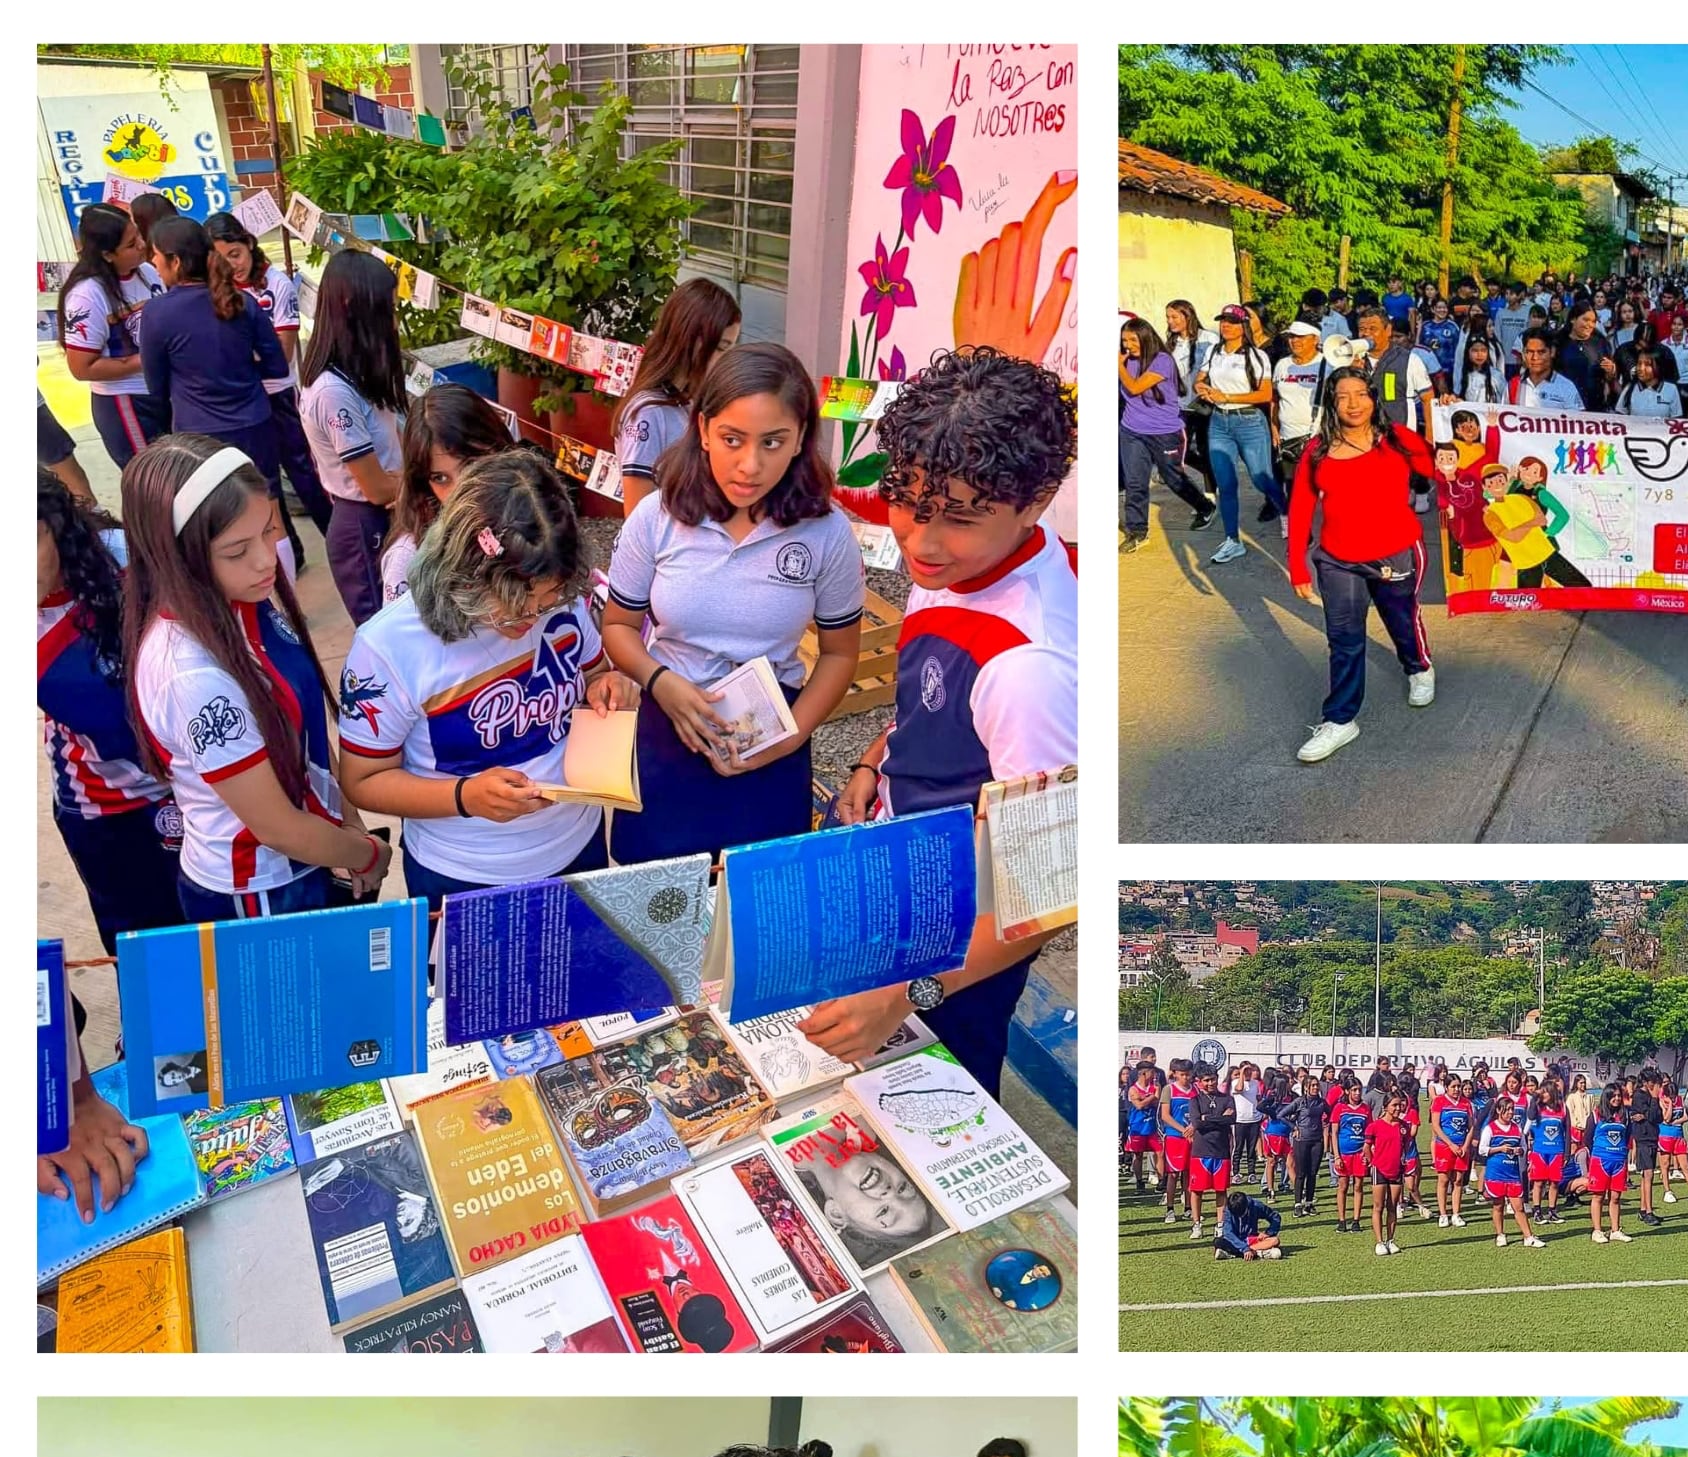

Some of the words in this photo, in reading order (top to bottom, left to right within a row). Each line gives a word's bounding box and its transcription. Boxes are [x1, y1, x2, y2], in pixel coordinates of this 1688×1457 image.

[1498, 411, 1628, 436] Caminata
[1675, 527, 1686, 538] El
[470, 680, 587, 750] Prep
[1276, 1054, 1327, 1067] CLUB
[315, 1125, 353, 1145] Sawyer
[354, 1117, 378, 1129] Tom
[324, 1127, 373, 1151] Aventuras
[534, 1143, 554, 1162] del
[589, 1135, 681, 1181] Stravaganza
[935, 1141, 1029, 1190] AMBIENTE
[467, 1155, 529, 1186] Edén
[453, 1167, 565, 1220] demonios
[544, 1190, 574, 1210] Los
[965, 1171, 1052, 1217] DESARROLLO
[531, 1210, 580, 1241] LYDIA
[469, 1228, 526, 1264] CACHO
[532, 1264, 579, 1294] EDITORIAL
[751, 1262, 792, 1287] COMEDIAS
[764, 1275, 800, 1299] MEJORES
[420, 1301, 462, 1327] NANCY
[354, 1317, 418, 1353] KILPATRICK
